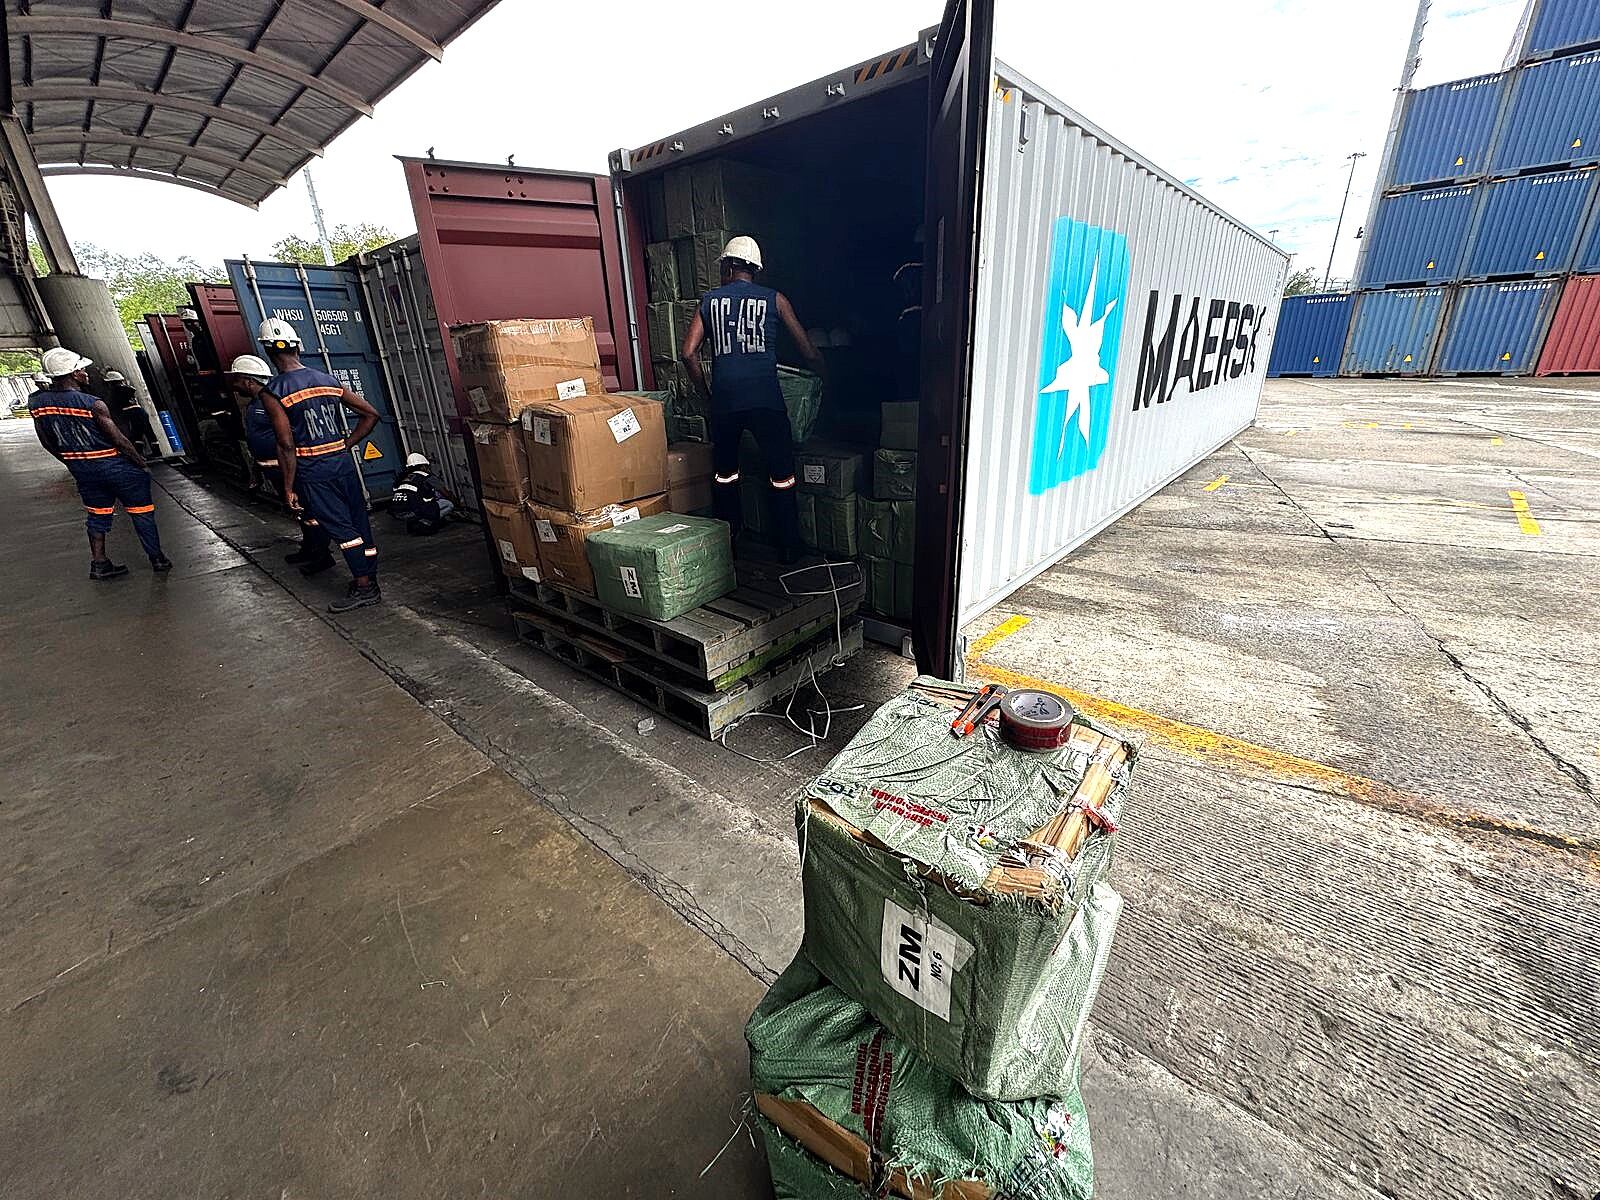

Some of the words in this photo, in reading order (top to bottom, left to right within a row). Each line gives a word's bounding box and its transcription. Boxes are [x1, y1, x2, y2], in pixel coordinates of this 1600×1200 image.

[273, 308, 304, 321] WHSU
[315, 309, 348, 321] 506509
[320, 323, 342, 335] 45G1
[710, 297, 767, 357] OC-493
[1132, 289, 1267, 412] MAERSK
[898, 923, 923, 993] ZM
[932, 950, 943, 961] 6
